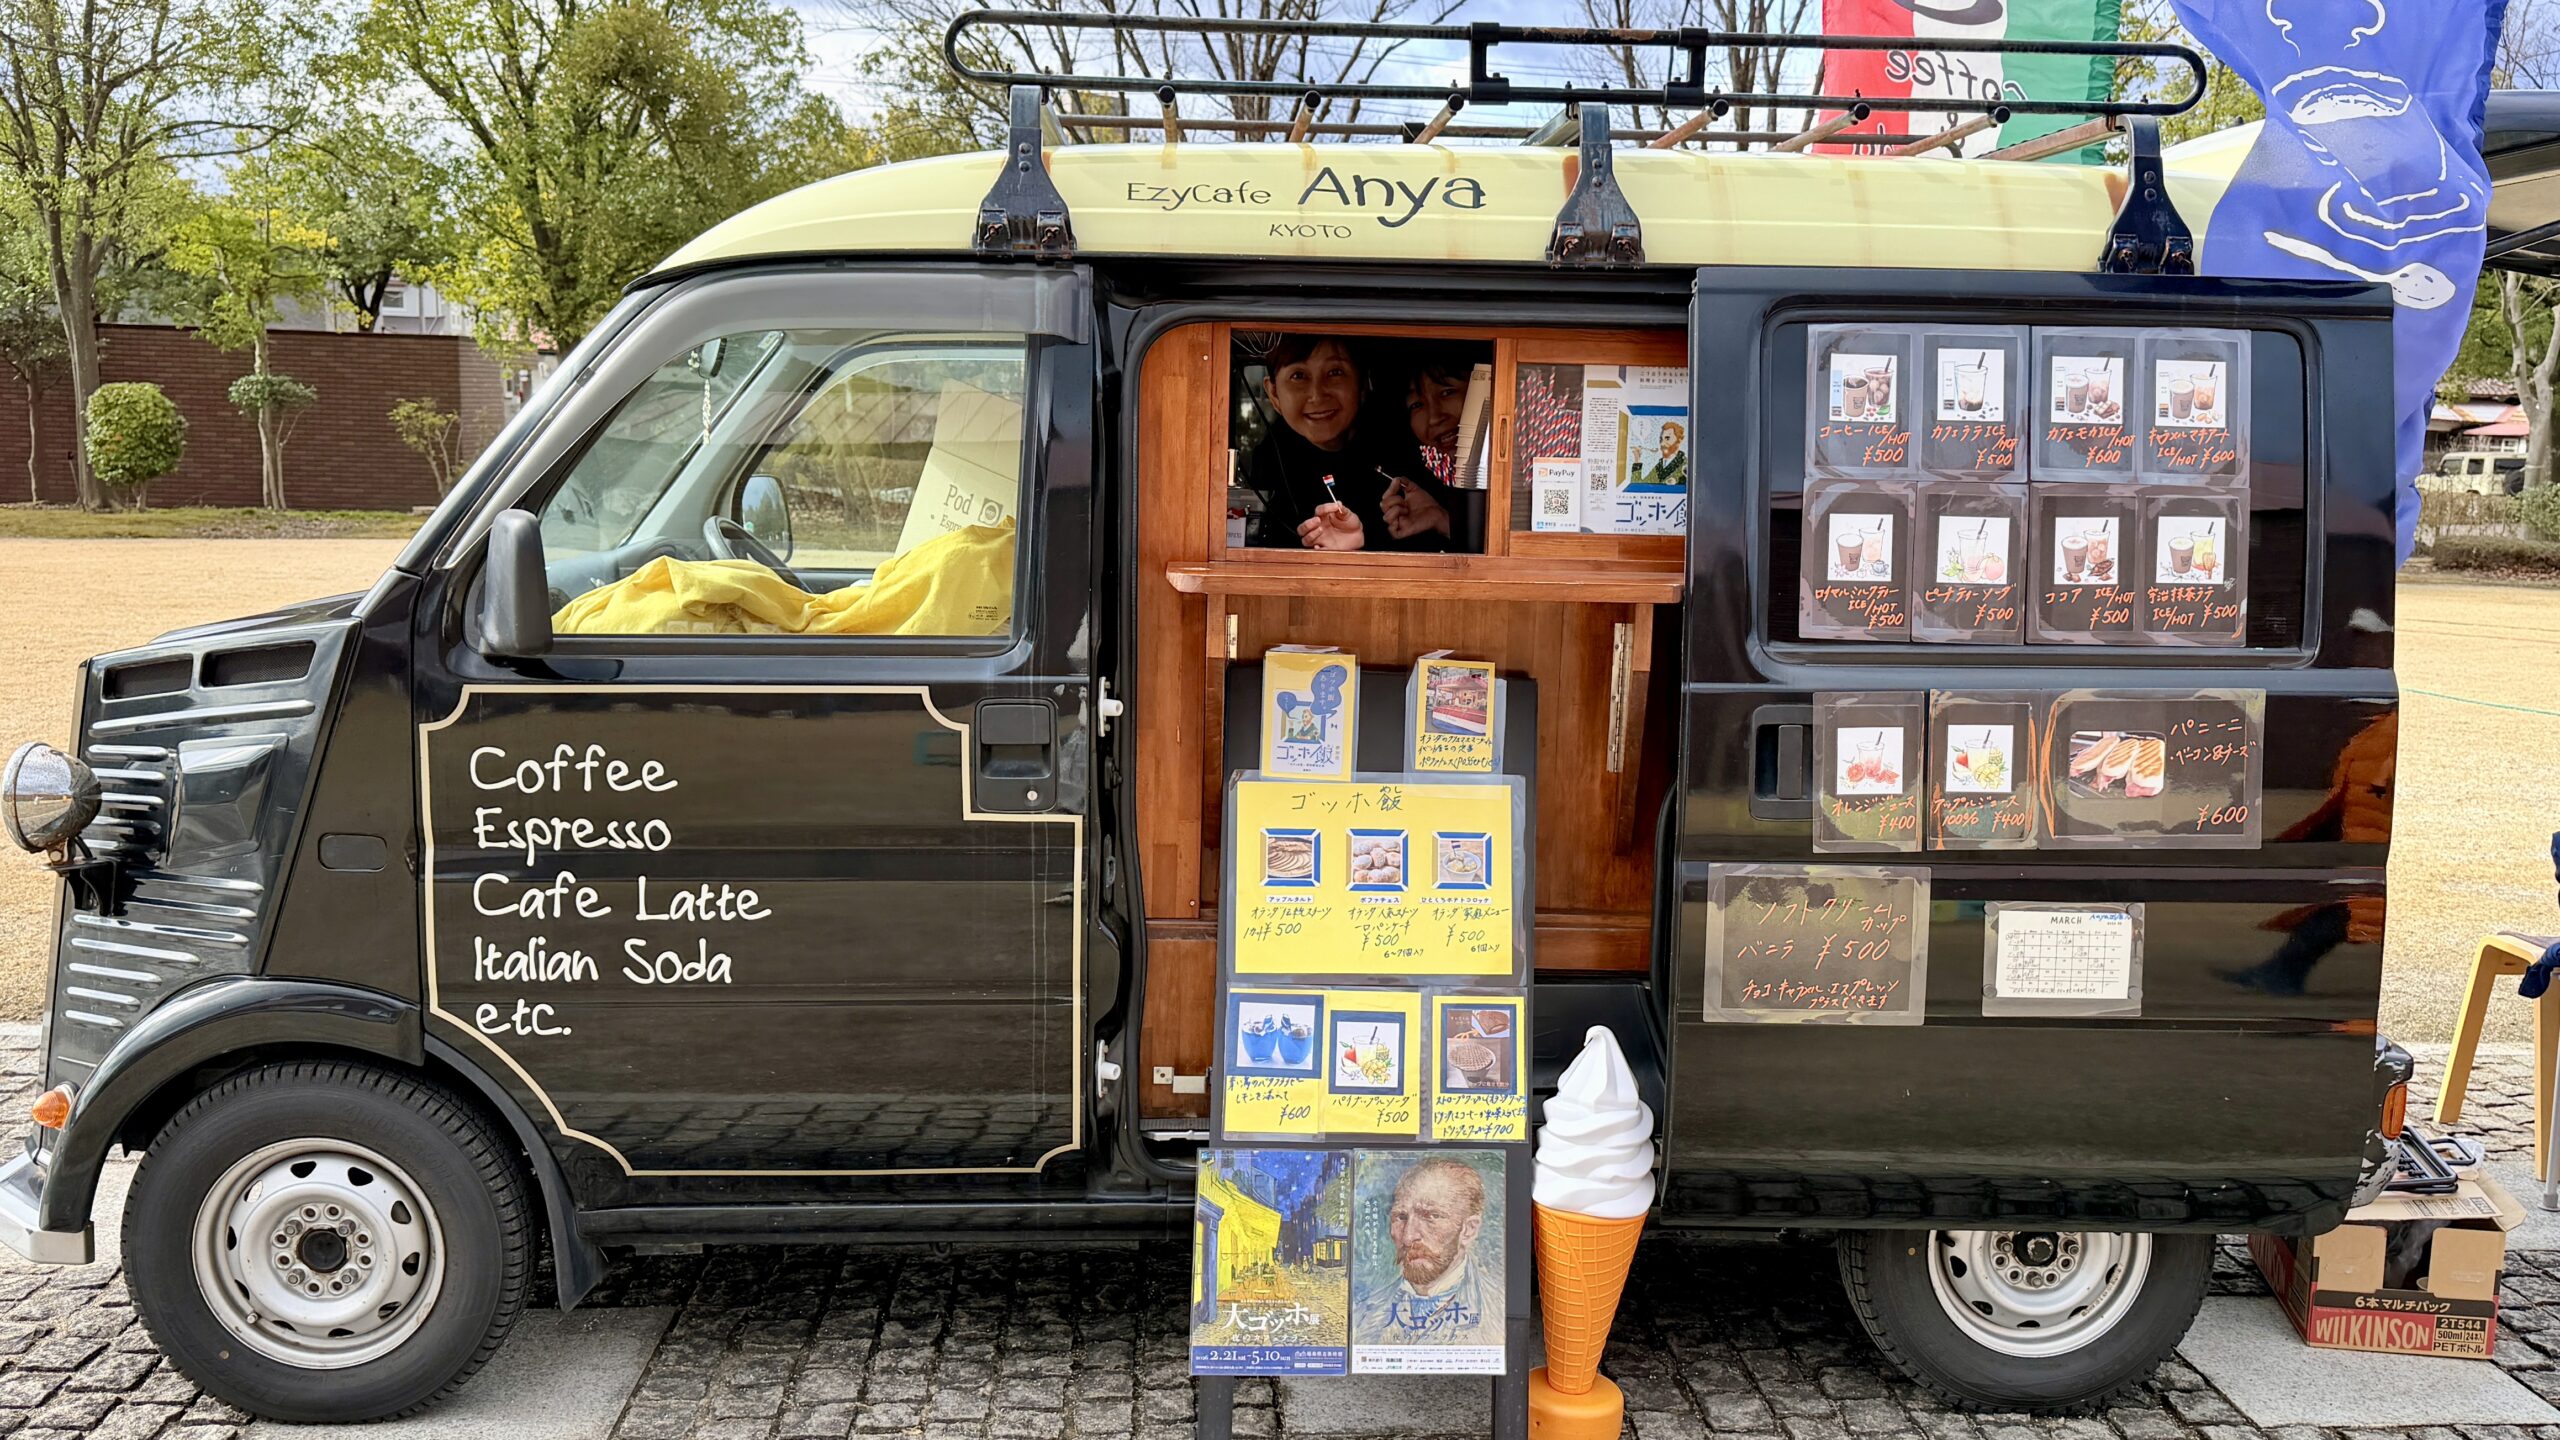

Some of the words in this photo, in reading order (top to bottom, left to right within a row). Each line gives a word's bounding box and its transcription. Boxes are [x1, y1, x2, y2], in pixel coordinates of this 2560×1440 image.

[1127, 180, 1272, 212] EzyCafe
[1297, 166, 1487, 228] Anya
[1269, 223, 1352, 239] KYOTO
[1863, 446, 1903, 466] ¥500
[1975, 448, 2012, 469] ¥500
[2085, 446, 2121, 467] ¥600
[2200, 446, 2235, 469] ¥600
[943, 484, 974, 515] Pod
[940, 514, 962, 532] Espre
[2046, 588, 2083, 605] ココア
[1868, 612, 1904, 630] ¥500
[1974, 604, 2014, 626] ¥500
[2089, 607, 2129, 631] ¥500
[2201, 603, 2237, 628] ¥500
[2171, 719, 2243, 736] パニーニ
[469, 743, 678, 794] Coffee
[1878, 814, 1916, 837] ¥400
[1941, 811, 1979, 827] 100%
[1992, 811, 2025, 832] ¥400
[2196, 804, 2248, 831] ¥600
[472, 806, 672, 867] Espresso
[473, 870, 612, 920] Cafe
[635, 875, 772, 922] Latte
[1861, 914, 1907, 935] カップ
[2050, 916, 2082, 925] MARCH
[474, 936, 599, 983] Italian
[622, 937, 733, 985] Soda
[1737, 939, 1794, 959] バニラ
[1815, 933, 1890, 970] ¥500
[475, 998, 572, 1037] etc.
[1279, 1103, 1311, 1126] ¥600
[1377, 1108, 1410, 1127] ¥500
[2354, 1296, 2452, 1313] 6本マルチパック
[1221, 1302, 1321, 1334] 大ゴッホ展
[1382, 1301, 1480, 1332] 大ゴッホ展
[2315, 1315, 2430, 1349] WILKINSON
[2439, 1318, 2482, 1330] 2T544
[2437, 1330, 2464, 1341] 500ml
[1209, 1350, 1237, 1361] 2.21
[2433, 1343, 2484, 1354] PETボトル
